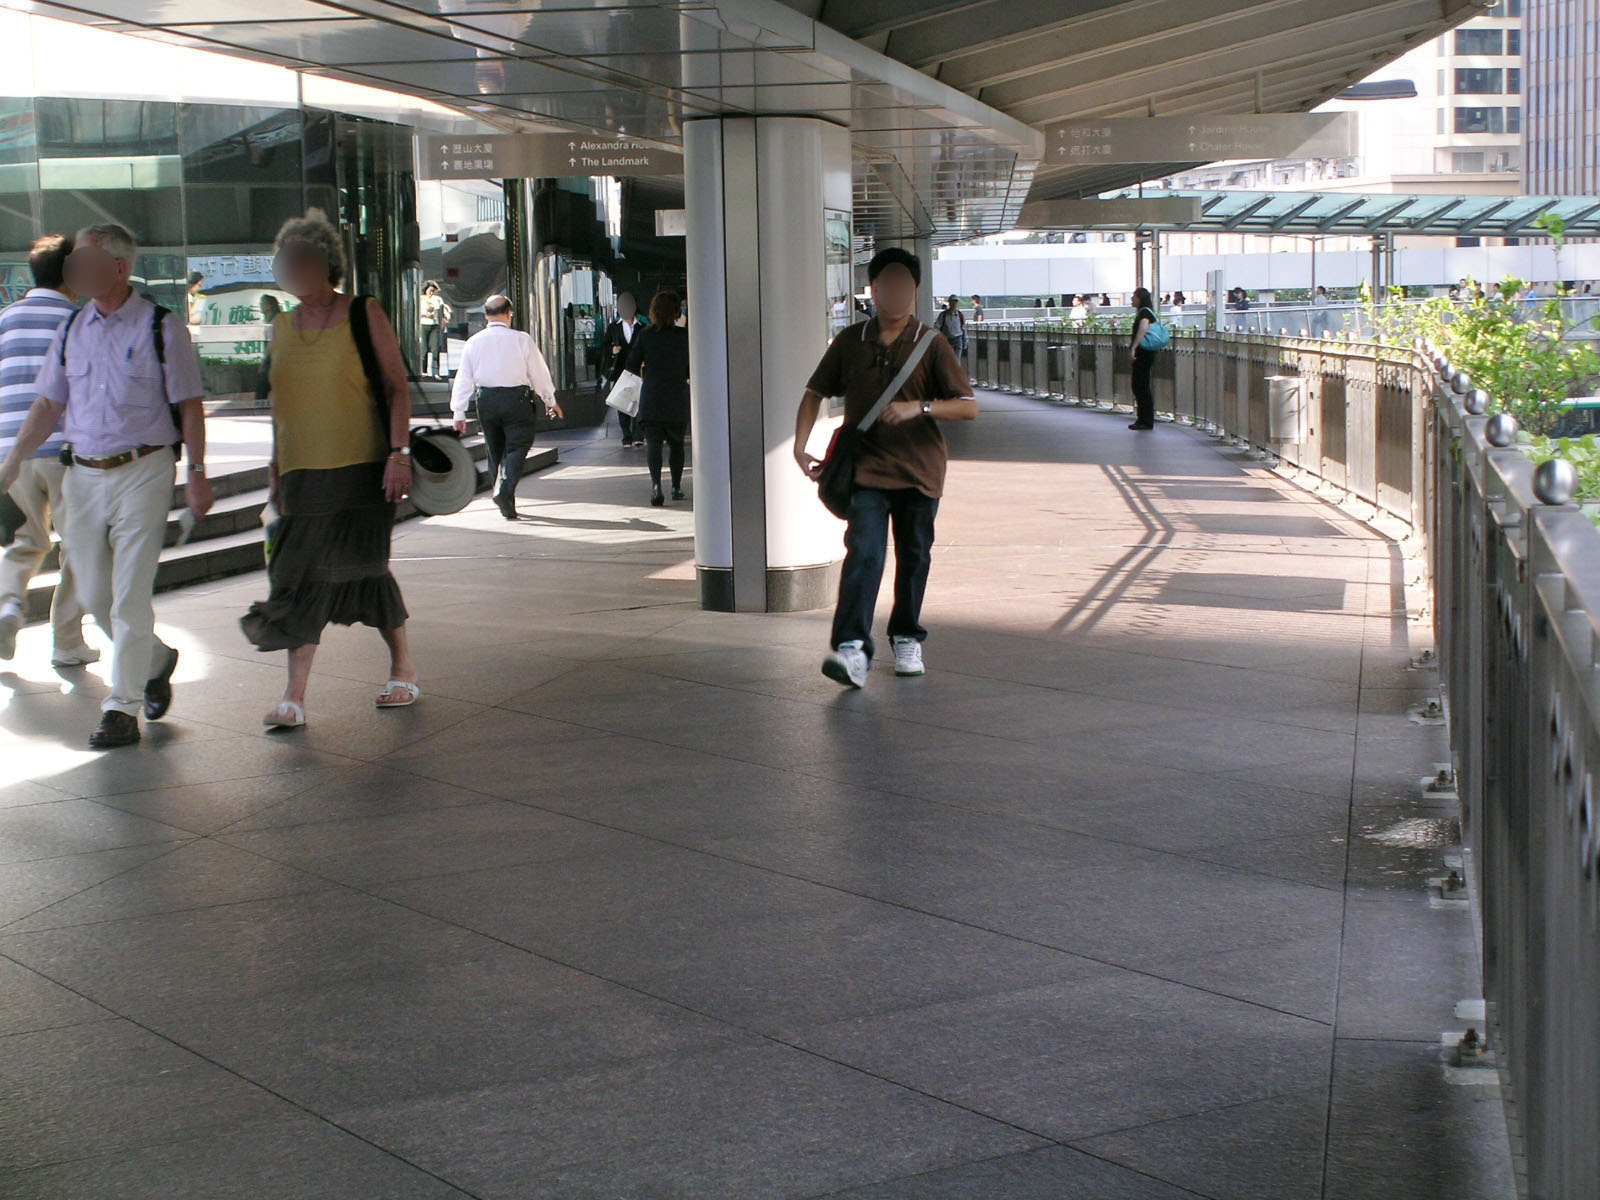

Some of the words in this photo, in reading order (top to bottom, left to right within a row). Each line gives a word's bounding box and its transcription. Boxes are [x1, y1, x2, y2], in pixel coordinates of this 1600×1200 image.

[580, 141, 629, 150] Alexandra
[581, 157, 600, 166] The
[601, 156, 649, 166] Landmark
